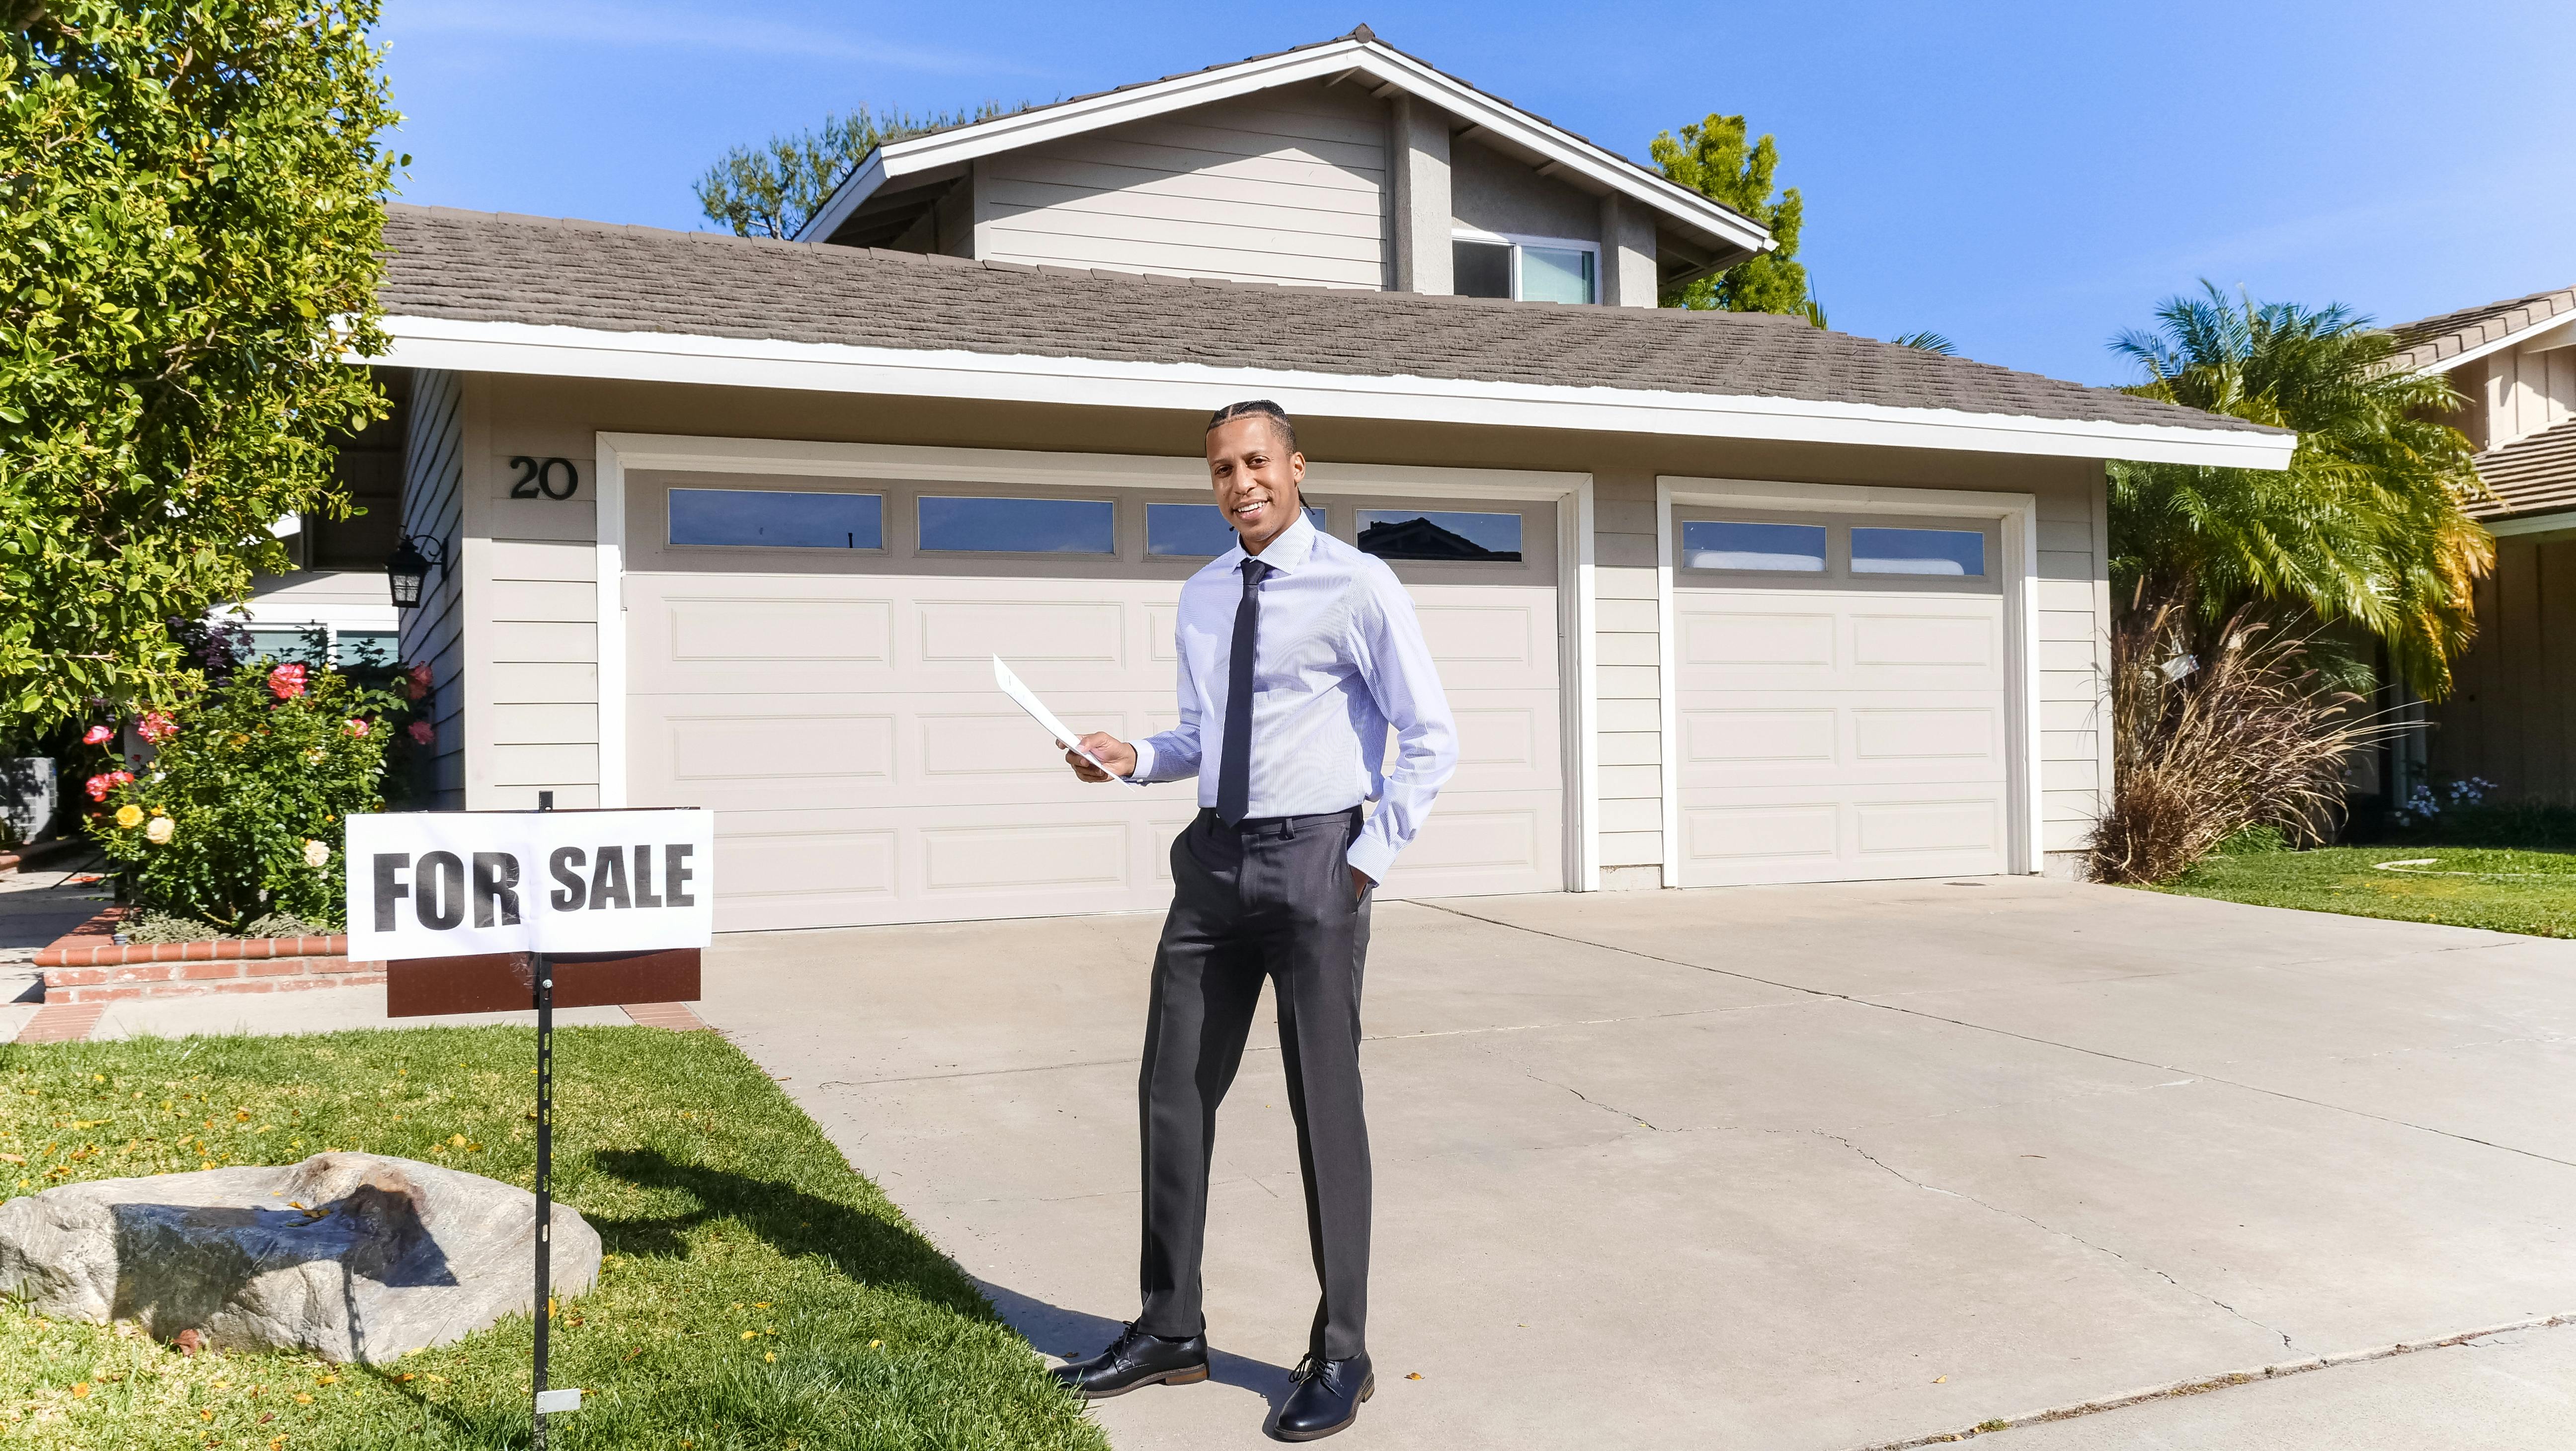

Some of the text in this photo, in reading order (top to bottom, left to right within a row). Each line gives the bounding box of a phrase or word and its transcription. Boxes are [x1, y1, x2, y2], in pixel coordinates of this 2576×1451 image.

[509, 455, 578, 499] 20
[373, 843, 695, 932] FOR SALE
